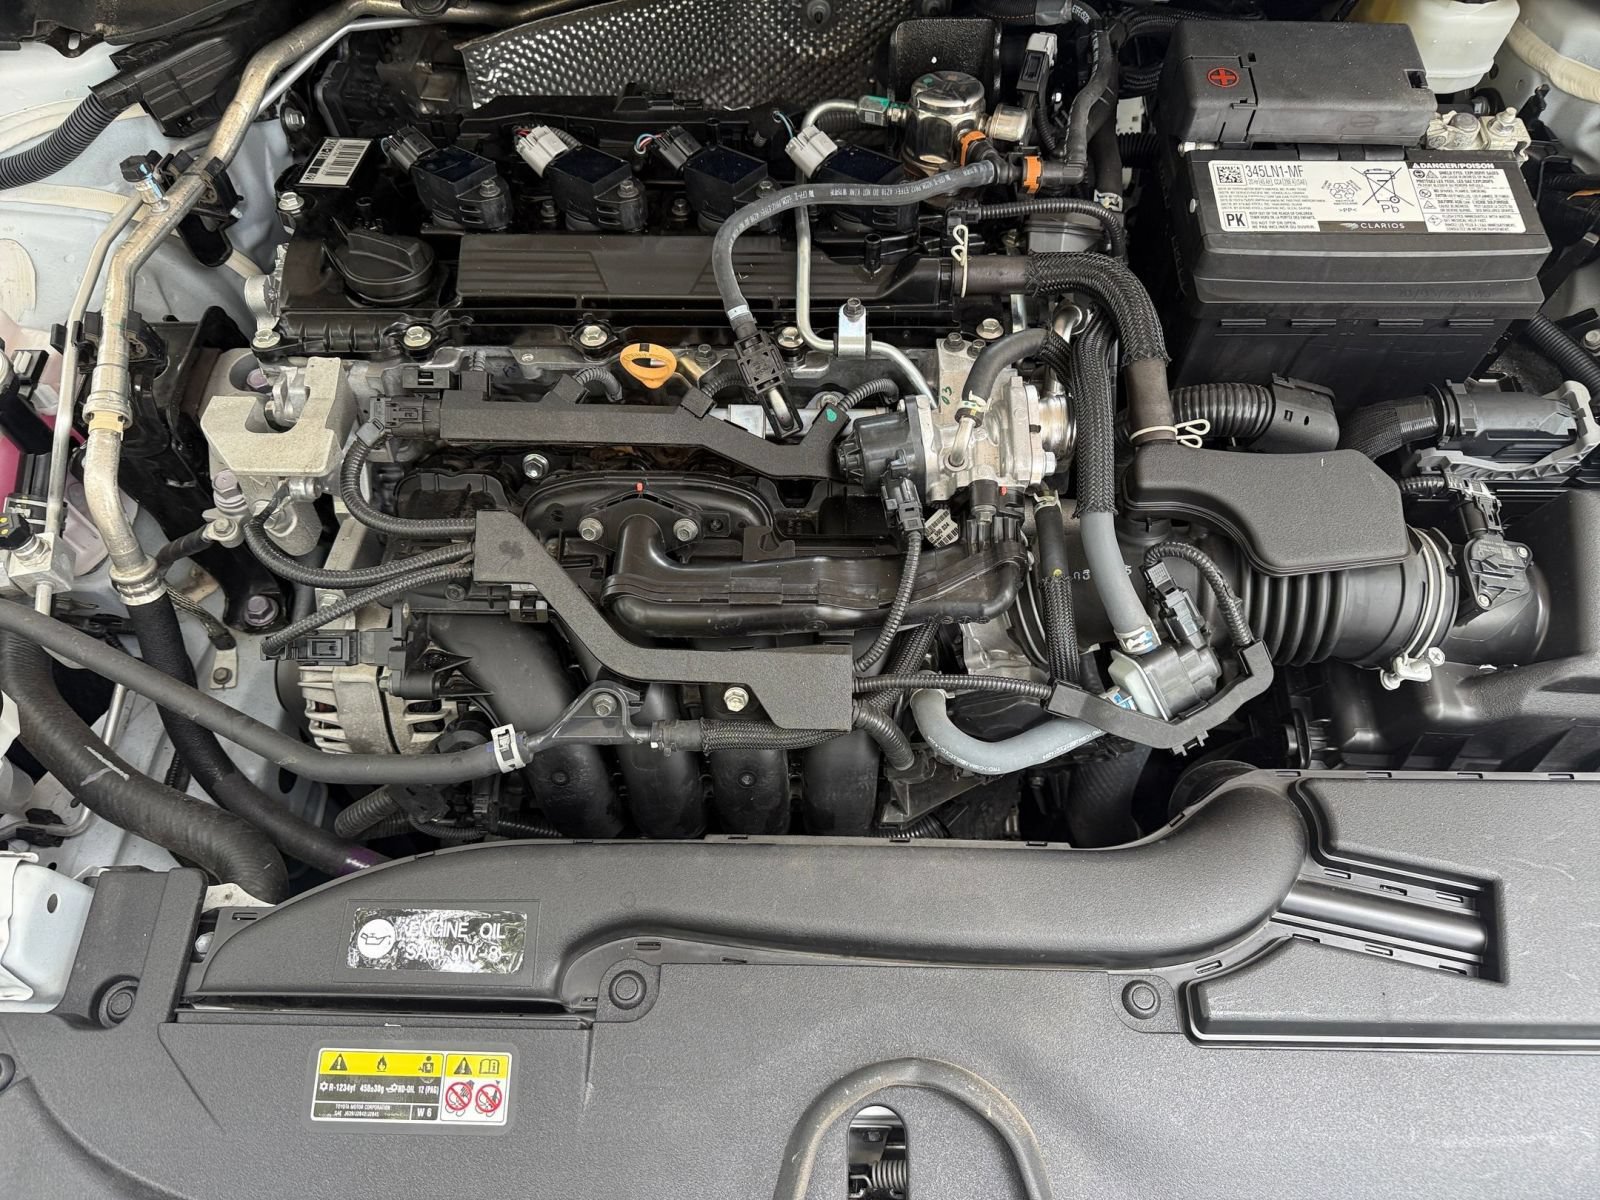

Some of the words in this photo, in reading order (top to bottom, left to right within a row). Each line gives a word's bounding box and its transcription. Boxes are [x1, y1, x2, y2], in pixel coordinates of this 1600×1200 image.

[1245, 164, 1304, 178] 345LN1-MF
[1381, 204, 1400, 213] Pb
[1226, 213, 1246, 227] PK
[406, 921, 469, 939] ENGINE
[480, 922, 506, 939] OIL
[417, 1107, 426, 1117] W
[426, 1107, 433, 1117] 6
